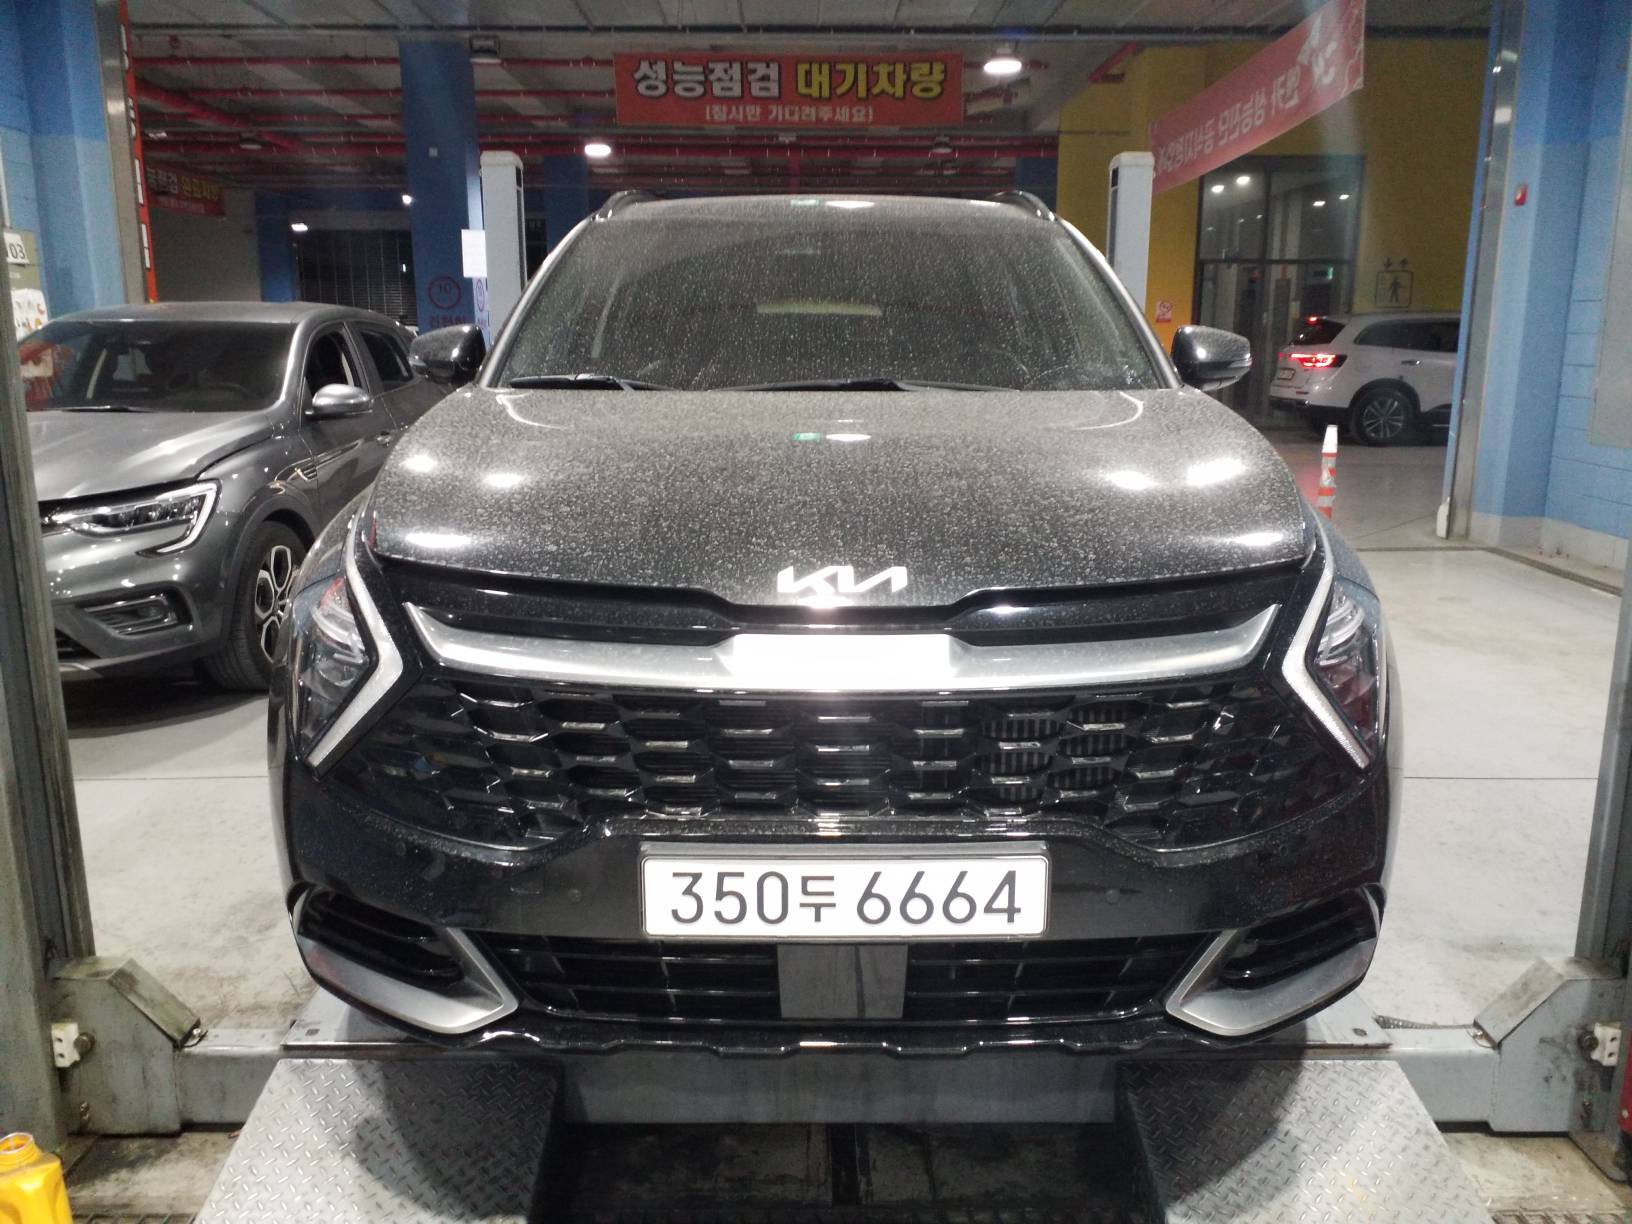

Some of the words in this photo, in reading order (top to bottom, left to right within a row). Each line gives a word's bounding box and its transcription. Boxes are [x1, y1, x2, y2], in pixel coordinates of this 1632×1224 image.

[633, 60, 781, 98] 성능점검
[796, 62, 945, 98] 대기차량
[777, 566, 908, 593] KIA
[671, 871, 836, 924] 350두
[856, 870, 1022, 924] 6664
